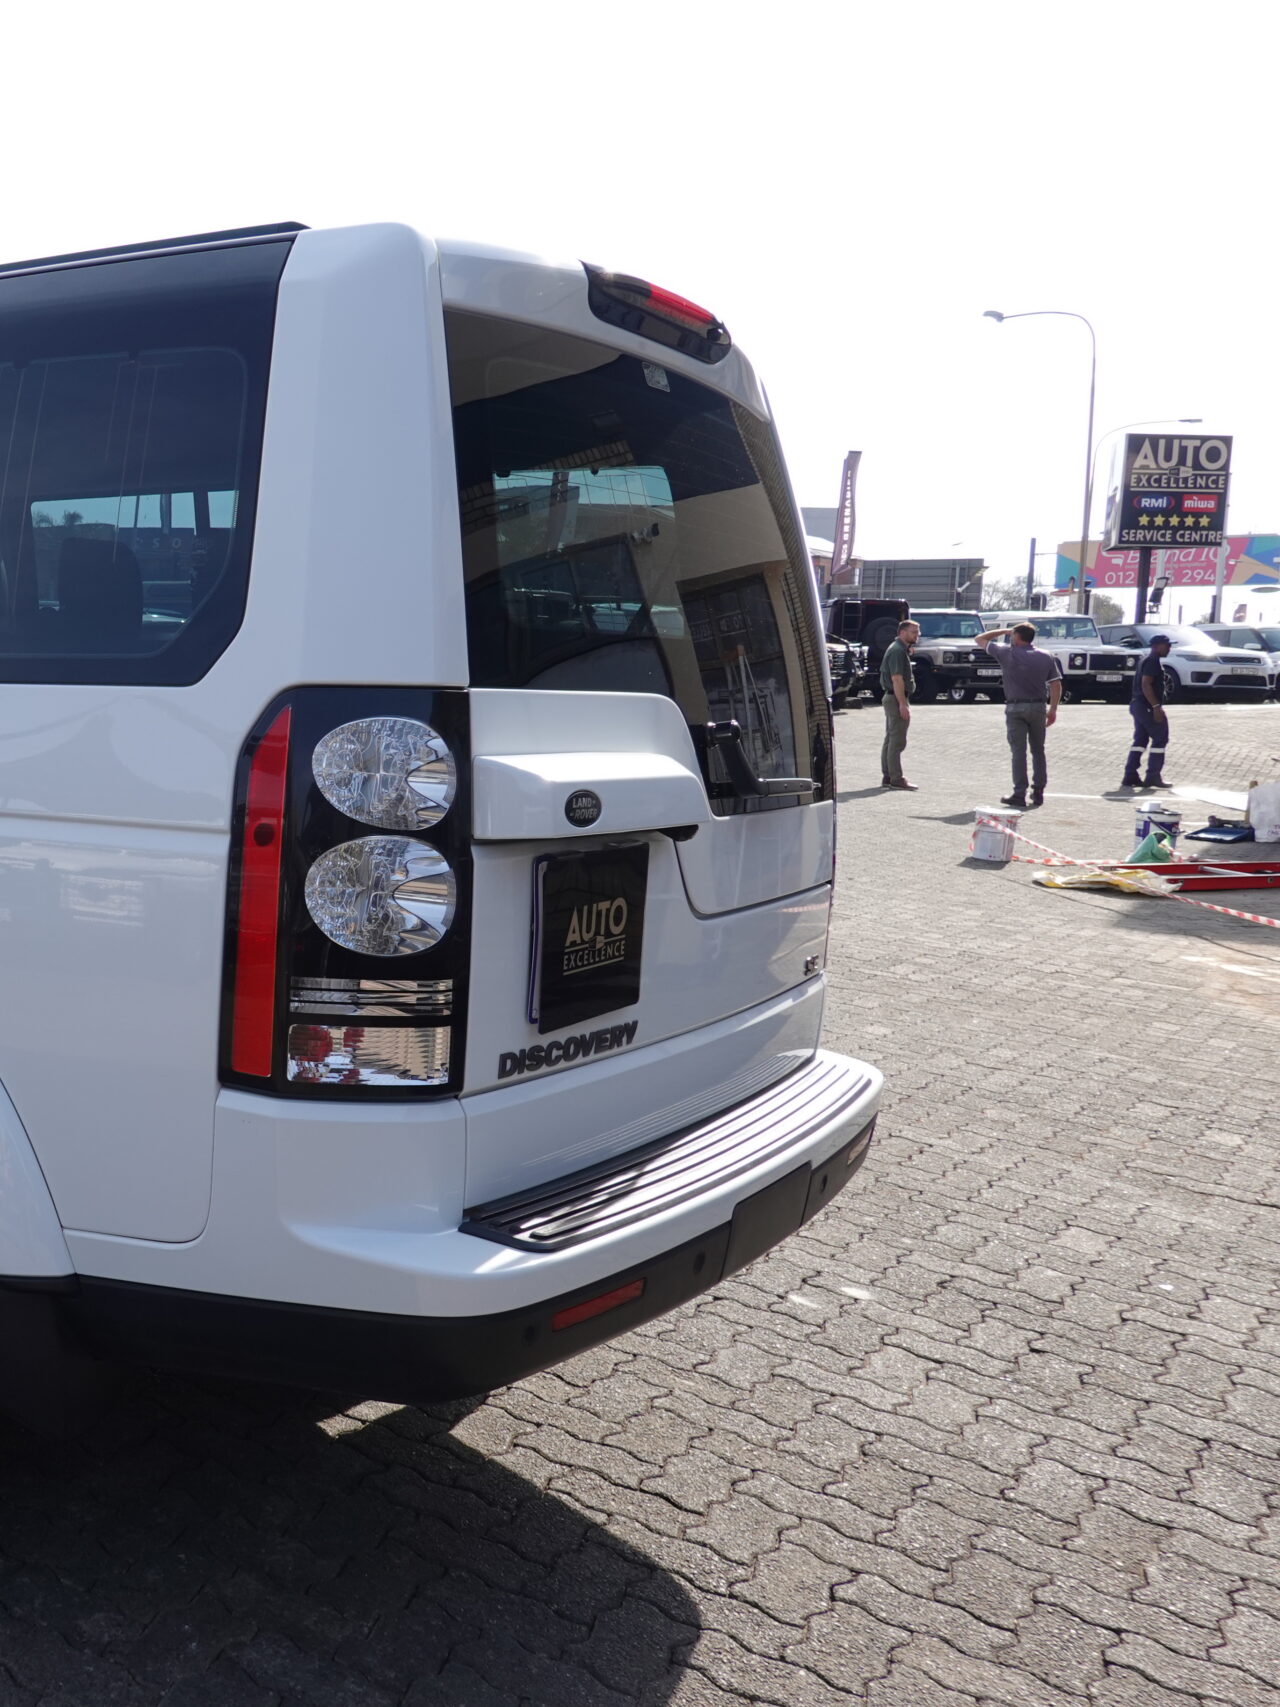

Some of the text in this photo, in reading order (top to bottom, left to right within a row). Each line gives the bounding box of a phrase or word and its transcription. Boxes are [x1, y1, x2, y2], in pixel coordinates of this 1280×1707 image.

[1131, 437, 1228, 471] AUTO
[1130, 474, 1226, 489] EXCELLENCE
[1121, 529, 1223, 543] SERVICE CENTRE
[1126, 547, 1187, 563] Band
[1105, 570, 1135, 585] 012
[572, 797, 592, 808] LAND
[574, 808, 598, 819] ROVER
[565, 896, 628, 947] AUTO
[563, 940, 626, 970] EXCELLENCE
[498, 1019, 638, 1080] DISCOVERY
